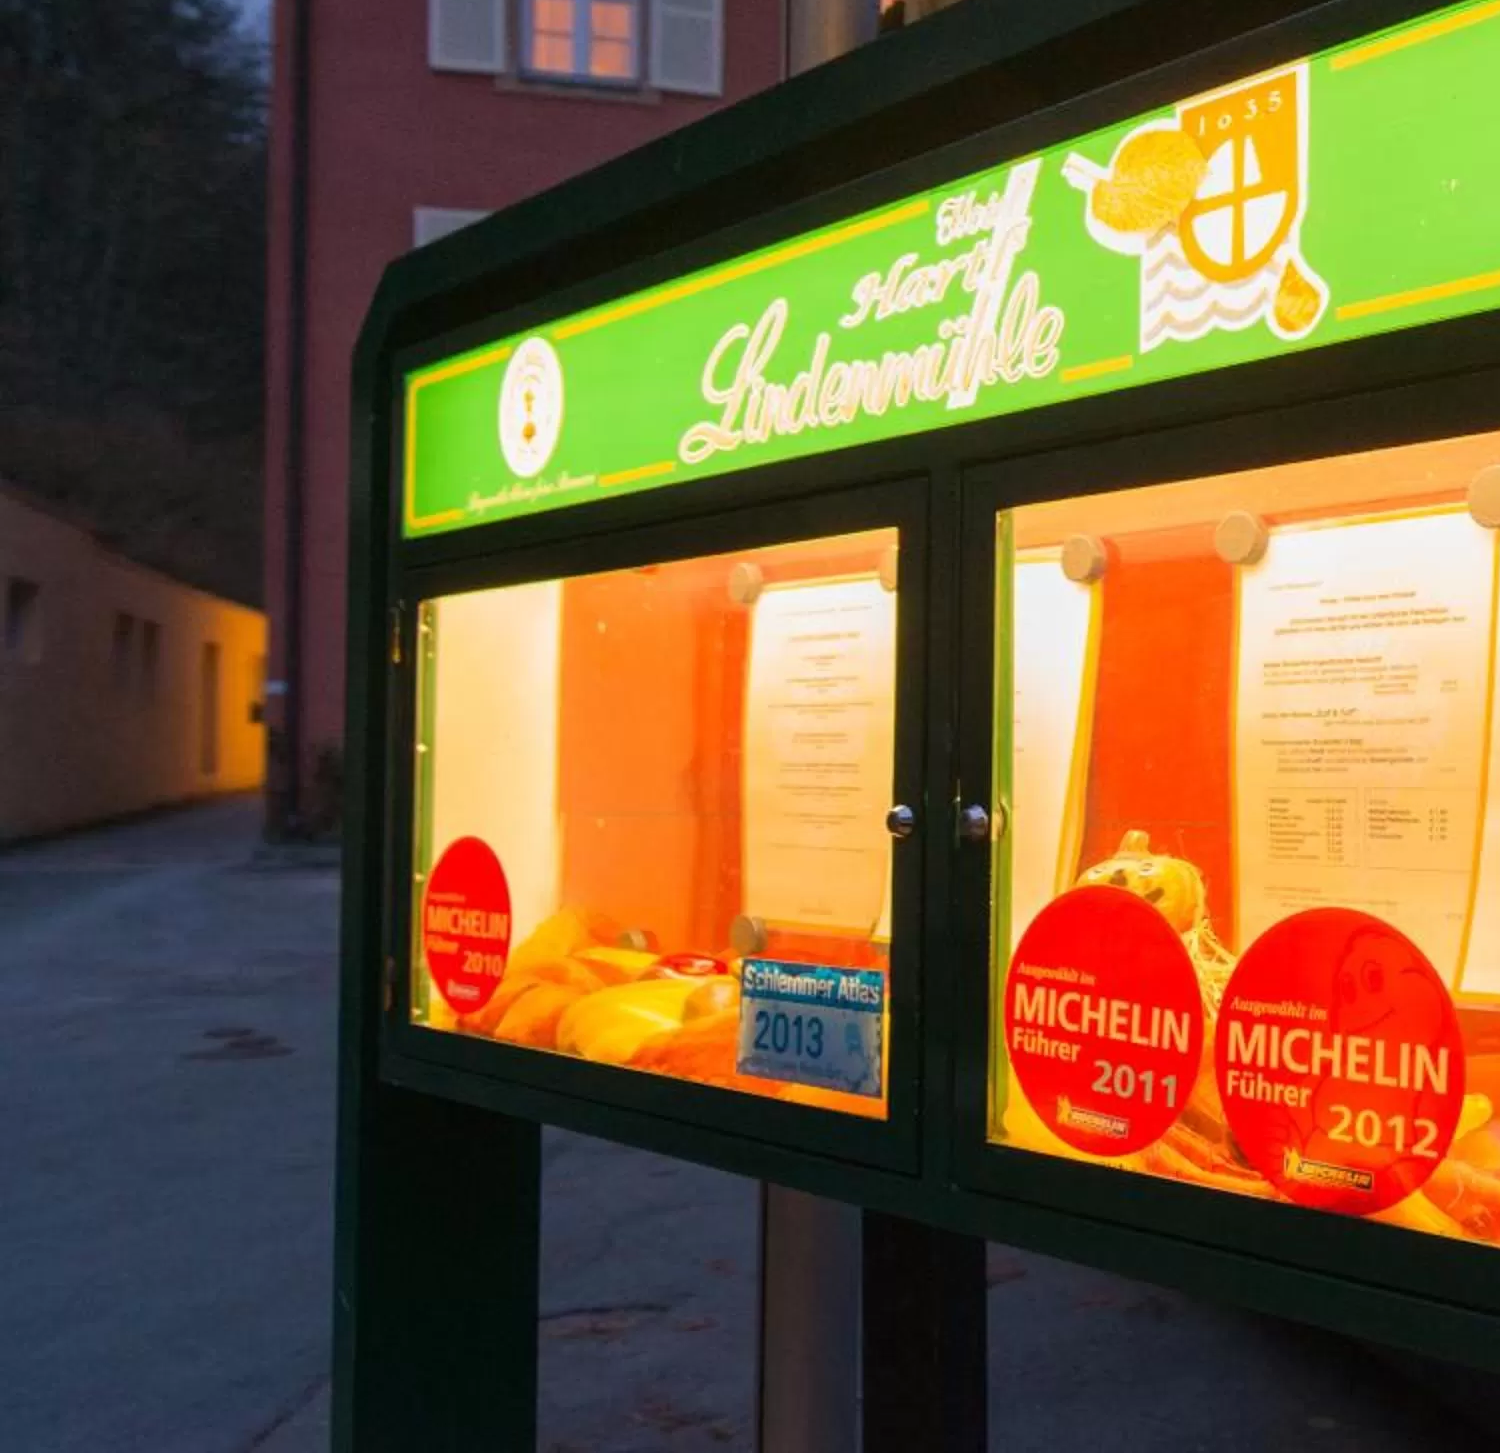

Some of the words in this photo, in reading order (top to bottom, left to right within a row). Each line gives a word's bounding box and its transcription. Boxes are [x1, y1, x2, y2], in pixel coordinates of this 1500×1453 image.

[678, 272, 1065, 464] Lindenmühle
[427, 905, 508, 940] MICHELIN
[462, 950, 503, 977] 2010
[743, 962, 835, 1000] Schlemmer
[838, 974, 880, 1005] Atlas
[1013, 983, 1190, 1054] MICHELIN
[1230, 994, 1307, 1019] Ausgewählt
[1308, 1004, 1329, 1022] im
[754, 1010, 825, 1060] 2013
[1012, 1025, 1081, 1063] Führer
[1227, 1020, 1450, 1094] MICHELIN
[1091, 1059, 1178, 1108] 2011
[1226, 1068, 1312, 1108] Führer
[1326, 1104, 1440, 1160] 2012
